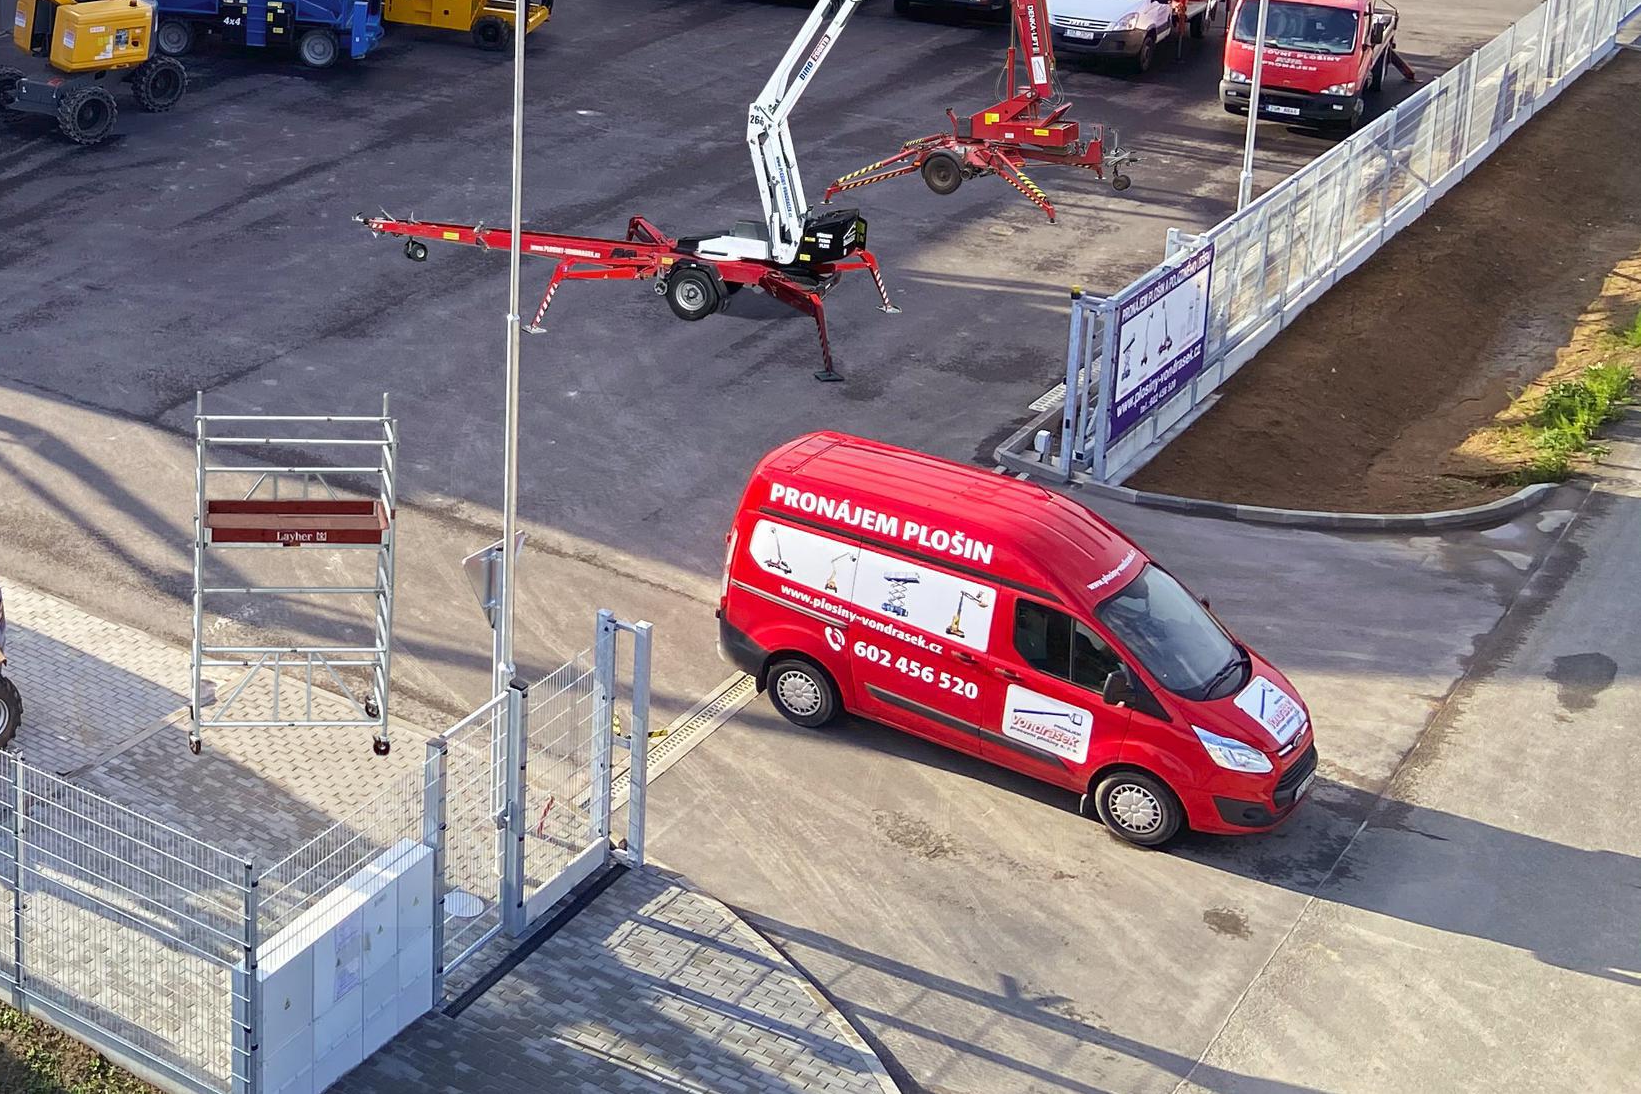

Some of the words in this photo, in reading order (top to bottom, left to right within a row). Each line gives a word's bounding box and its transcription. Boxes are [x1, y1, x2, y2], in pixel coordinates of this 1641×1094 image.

[223, 16, 241, 25] 4x4
[799, 61, 813, 81] DINO
[1116, 344, 1201, 417] www.plosiny-vondrasek.cz
[276, 531, 313, 542] Layher
[770, 482, 898, 537] PRONÁJEM
[902, 520, 993, 565] PLOŠIN
[781, 584, 944, 655] www.plosiny-vondrasek.cz
[854, 641, 891, 668] 602
[895, 656, 935, 683] 456
[938, 671, 979, 699] 520
